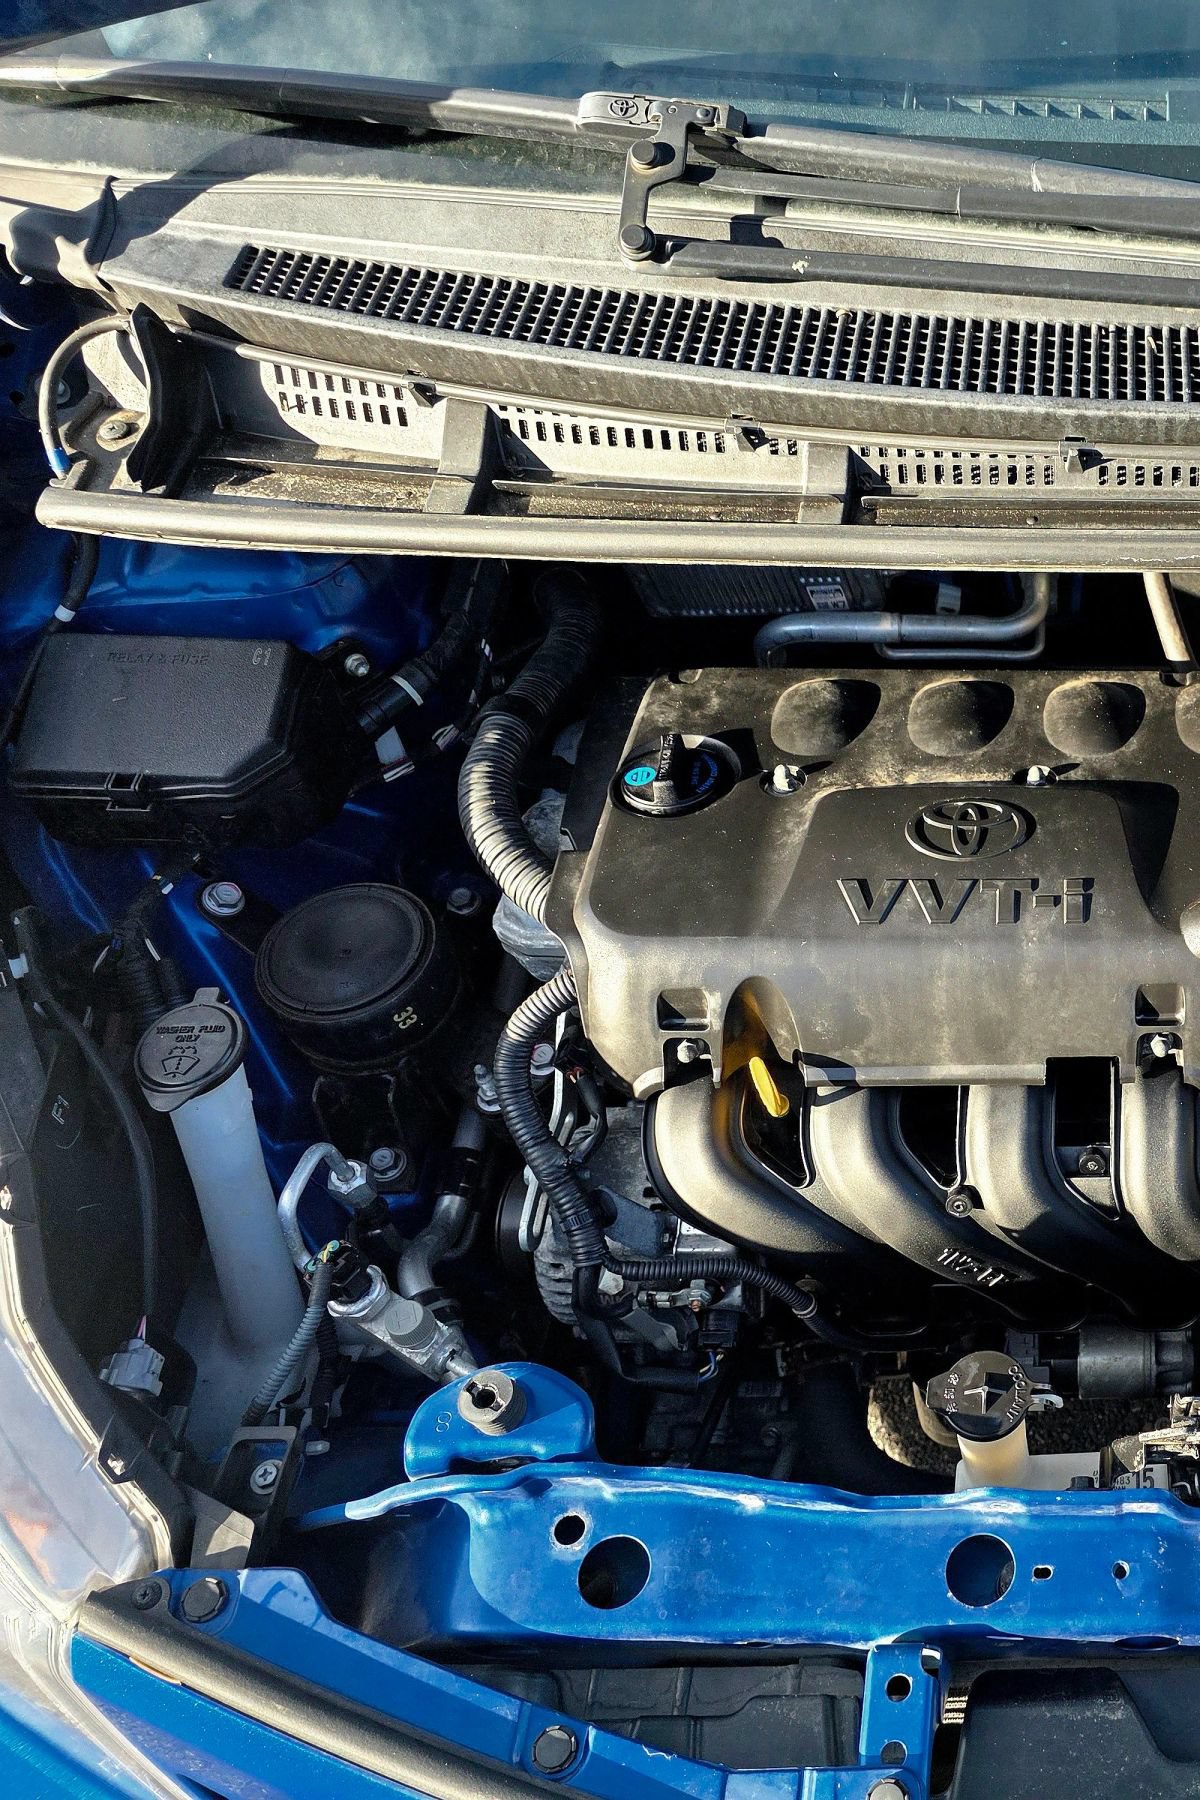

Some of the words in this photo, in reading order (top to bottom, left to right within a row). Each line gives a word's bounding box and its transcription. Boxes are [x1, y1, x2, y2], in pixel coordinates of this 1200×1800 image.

[836, 877, 1096, 924] VVT-i
[393, 1006, 418, 1029] 33
[156, 1025, 195, 1034] WASHER
[198, 1025, 226, 1034] FLUID
[175, 1034, 200, 1042] ONLY
